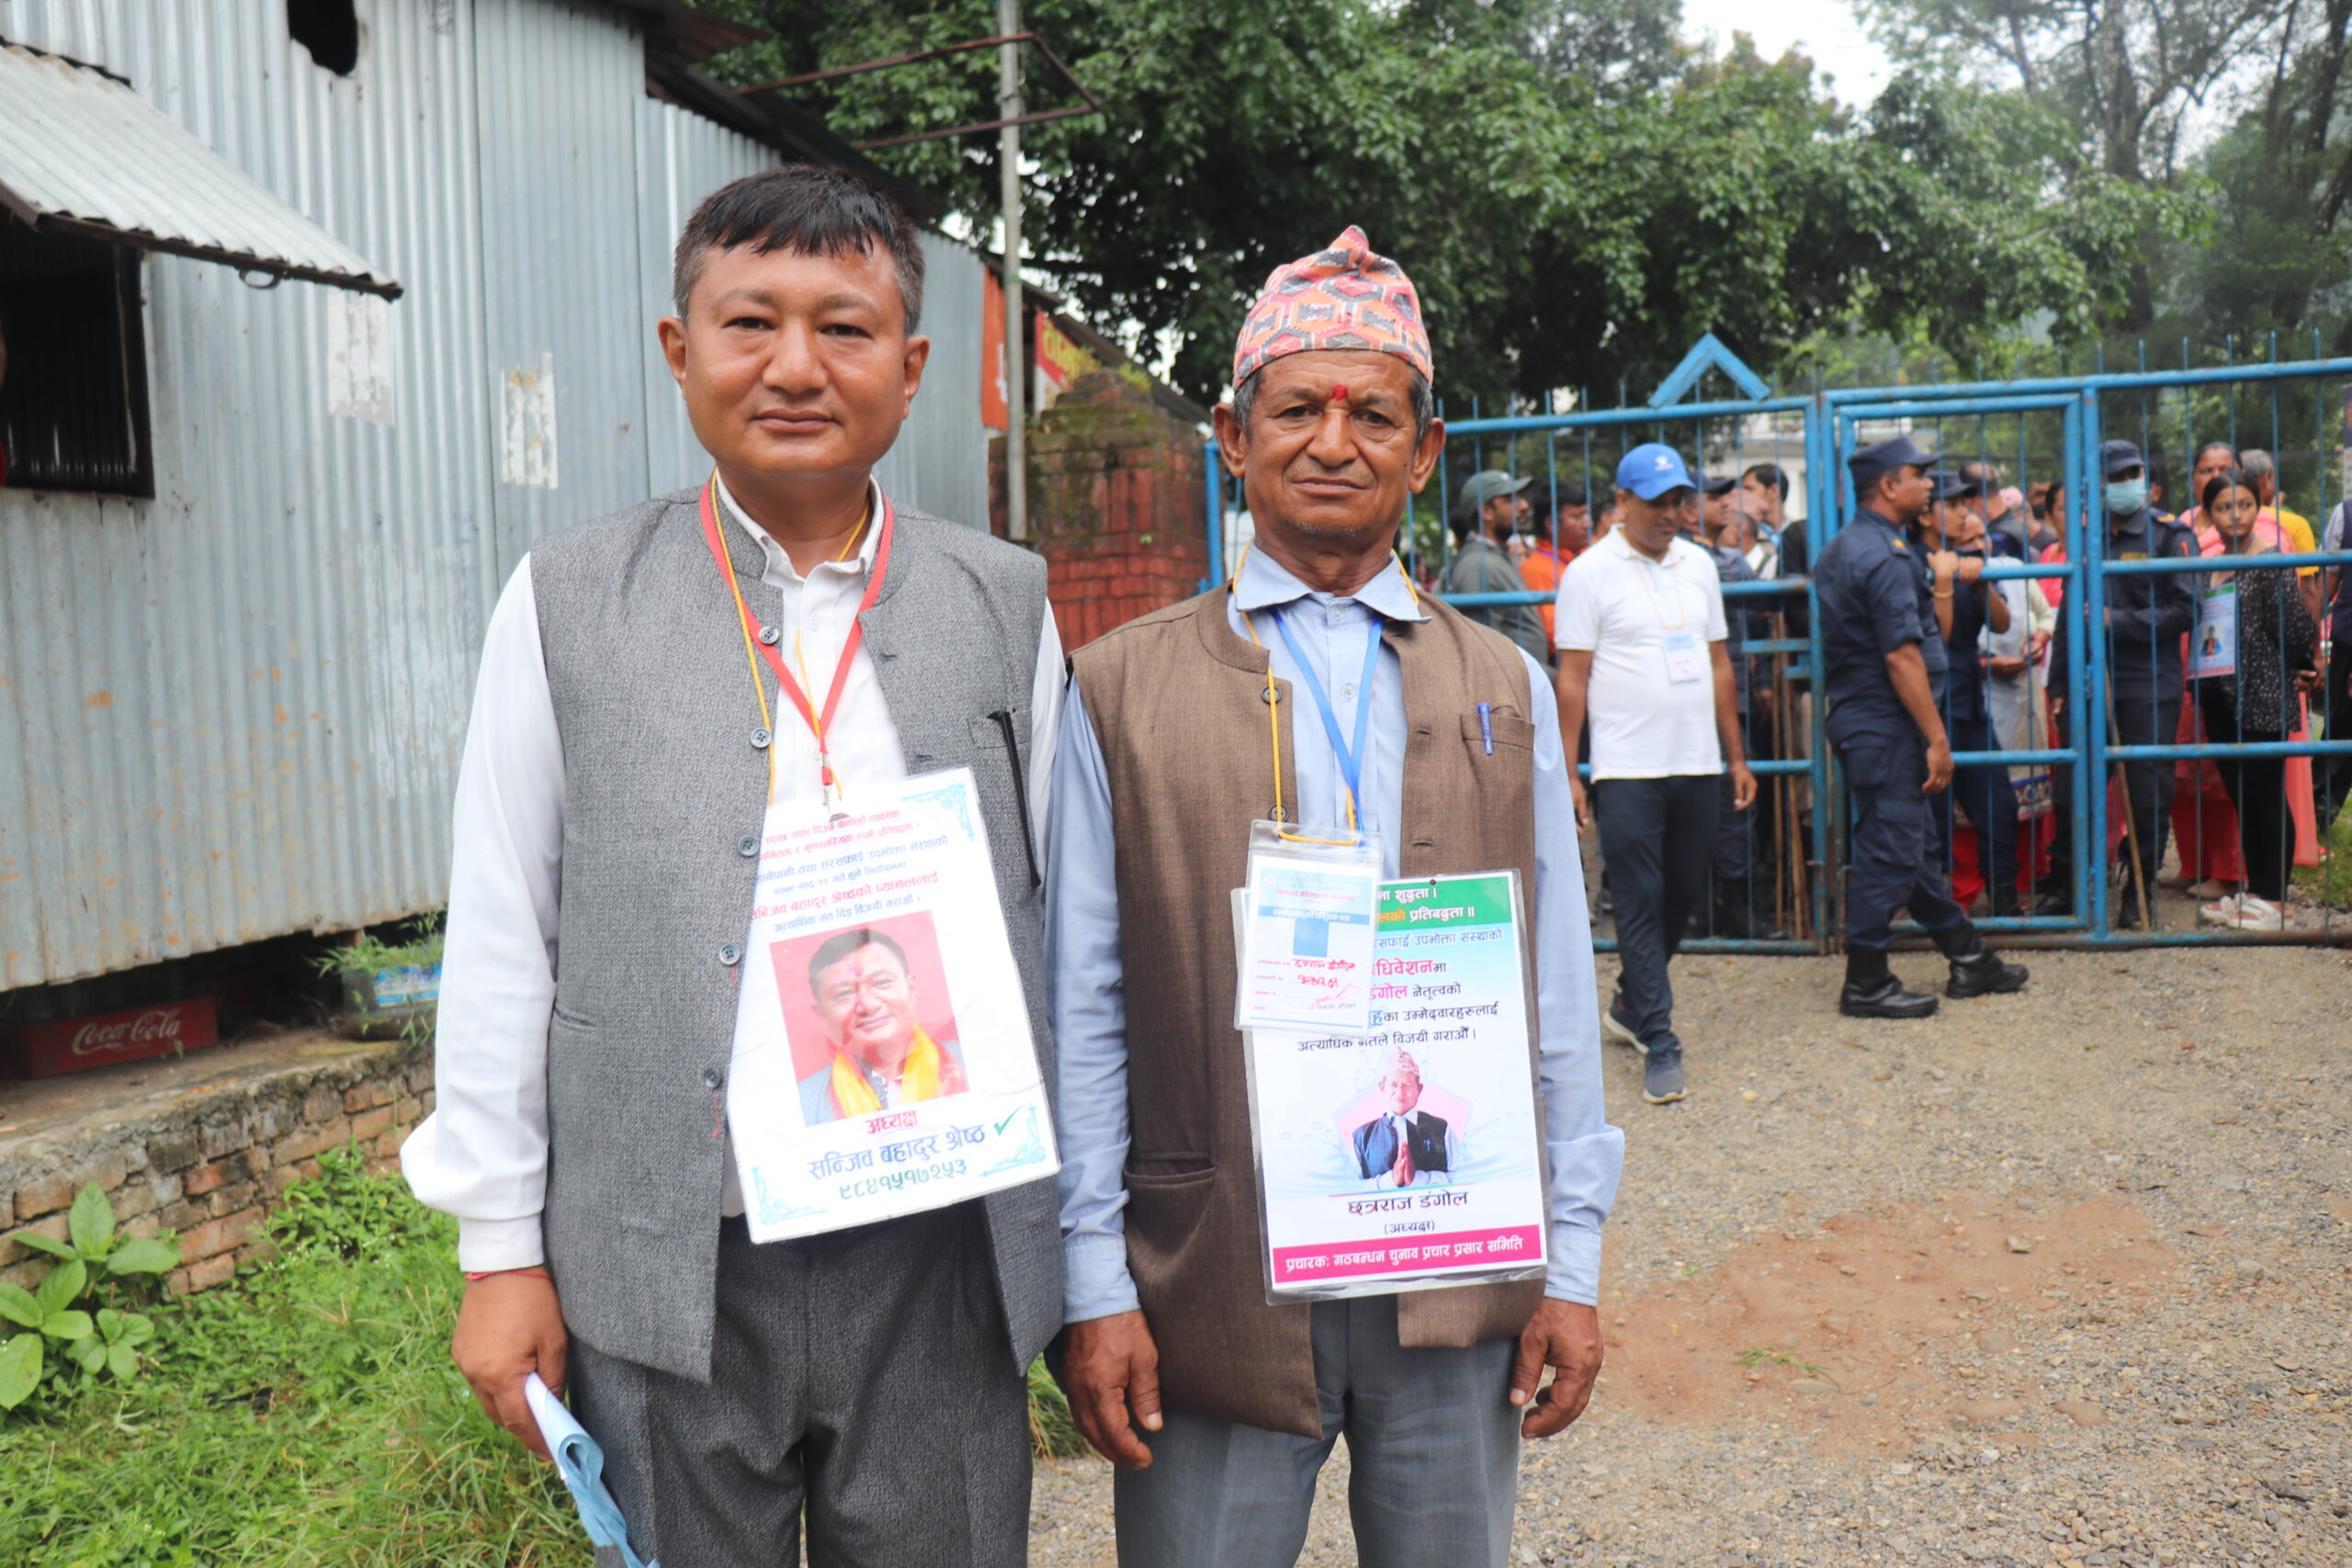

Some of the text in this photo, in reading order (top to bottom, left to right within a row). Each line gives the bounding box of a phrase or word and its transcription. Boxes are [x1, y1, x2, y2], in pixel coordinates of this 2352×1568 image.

[797, 863, 817, 876] तथा
[854, 900, 884, 916] विजयी
[1375, 908, 1406, 924] लको
[1415, 931, 1456, 947] उपभोक्ता
[1461, 927, 1503, 943] संस्थाको
[1372, 957, 1447, 977] धिवेशनमा
[1412, 981, 1462, 1001] नेतृत्वको
[1393, 1030, 1428, 1044] विजयी
[865, 1110, 918, 1134] अध्यक्ष
[808, 1124, 986, 1180] सन्जिव बहादुर श्रेष्ठ
[1348, 1190, 1469, 1216] छत्रराज डंगोल
[1385, 1220, 1435, 1235] (अध्यक्ष)
[1389, 1247, 1419, 1266] चुनाव
[1422, 1244, 1451, 1260] प्रचार
[1453, 1241, 1484, 1258] प्रसार
[1487, 1235, 1523, 1253] समिति
